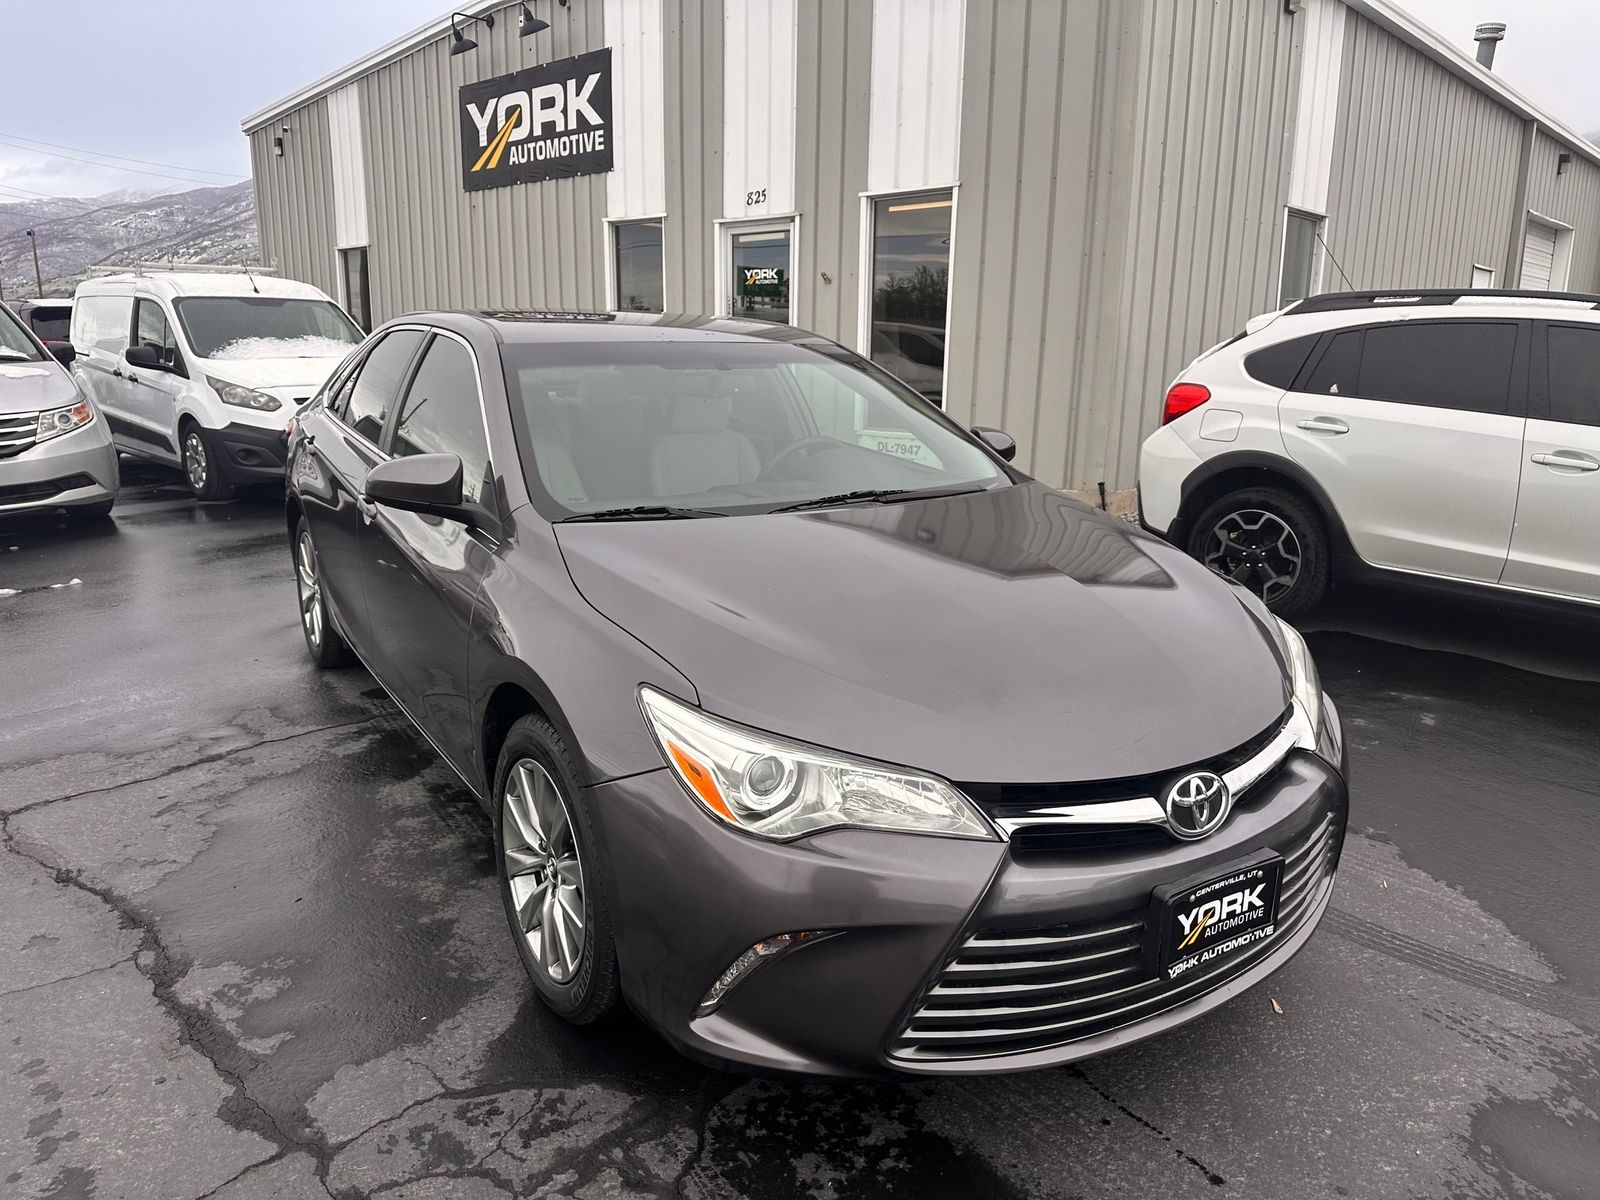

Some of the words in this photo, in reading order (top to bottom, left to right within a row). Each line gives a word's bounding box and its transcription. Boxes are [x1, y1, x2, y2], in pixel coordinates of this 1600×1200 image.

[466, 72, 604, 147] YORK
[509, 130, 604, 165] AUTOMOTIVE
[747, 189, 767, 206] 825
[744, 268, 778, 279] YORK
[877, 441, 921, 456] DL:7947
[1196, 874, 1246, 897] CENTERVILLE,
[1247, 870, 1258, 878] UT
[1178, 883, 1266, 936] YORK
[1205, 907, 1264, 938] AUTOMOTIVE
[1201, 925, 1274, 962] AUTOMOTIVE
